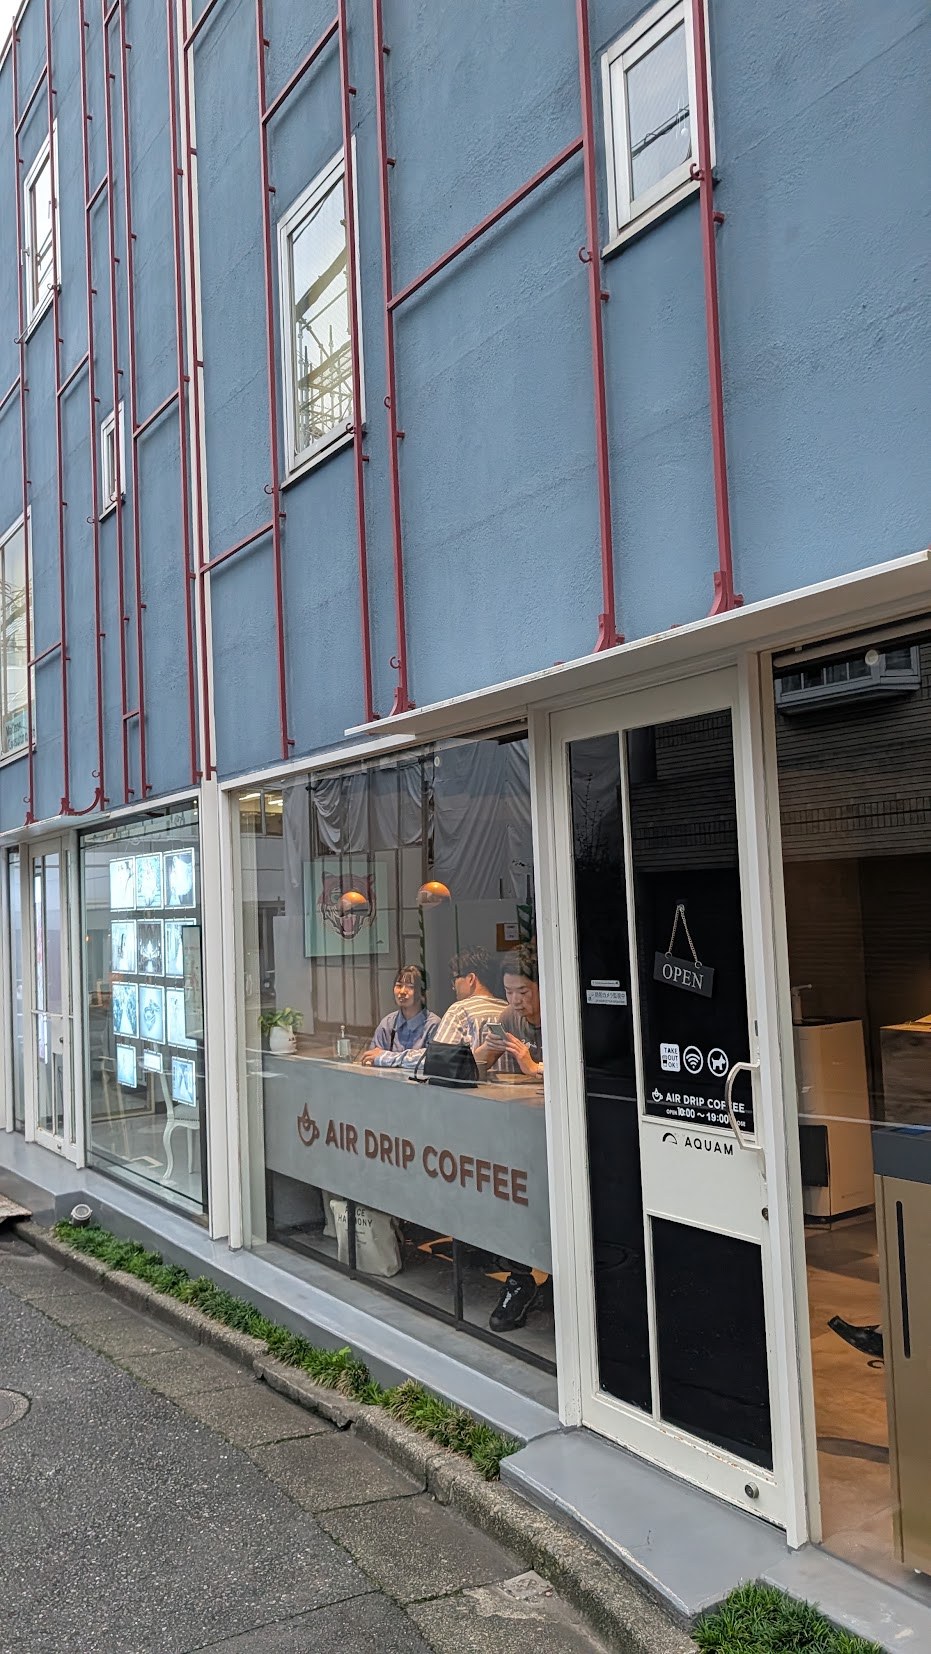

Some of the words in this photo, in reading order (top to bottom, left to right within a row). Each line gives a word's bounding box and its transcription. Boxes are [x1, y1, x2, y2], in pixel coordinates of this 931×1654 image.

[662, 963, 704, 990] OPEN
[665, 1092, 681, 1103] AIR
[683, 1094, 705, 1107] DRIP
[707, 1098, 746, 1114] COFEE
[706, 1111, 729, 1124] 19:00
[684, 1136, 734, 1156] AQUAM
[325, 1119, 359, 1156] AIR
[364, 1129, 416, 1170] DRIP
[422, 1145, 529, 1207] COFFEE
[337, 1214, 373, 1228] HAONY
